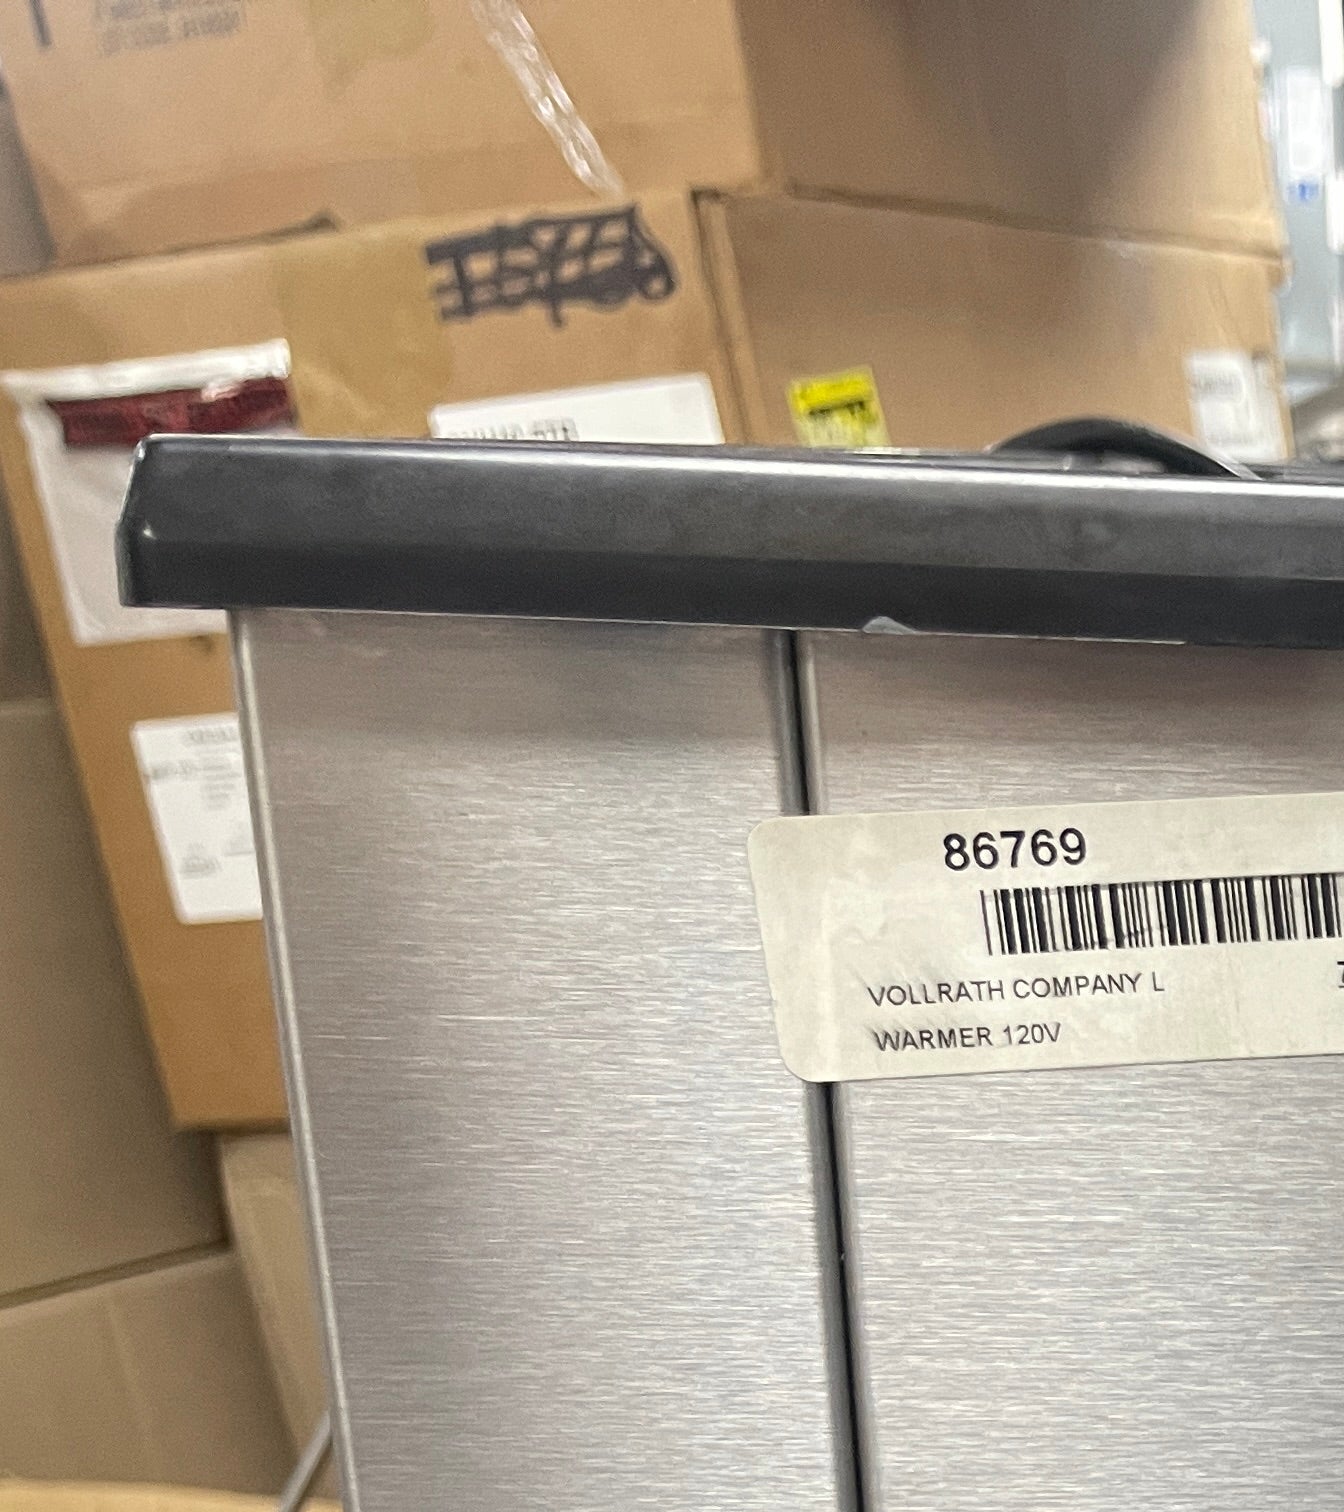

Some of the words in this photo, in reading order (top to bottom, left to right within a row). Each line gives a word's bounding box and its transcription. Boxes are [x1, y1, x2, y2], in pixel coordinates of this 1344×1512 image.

[943, 828, 1086, 870] 86769
[868, 979, 1005, 1007] VOLLRATH
[1012, 973, 1142, 1000] COMPANY
[1152, 973, 1165, 993] L
[875, 1025, 993, 1052] WARMER
[1003, 1023, 1062, 1046] 120V
